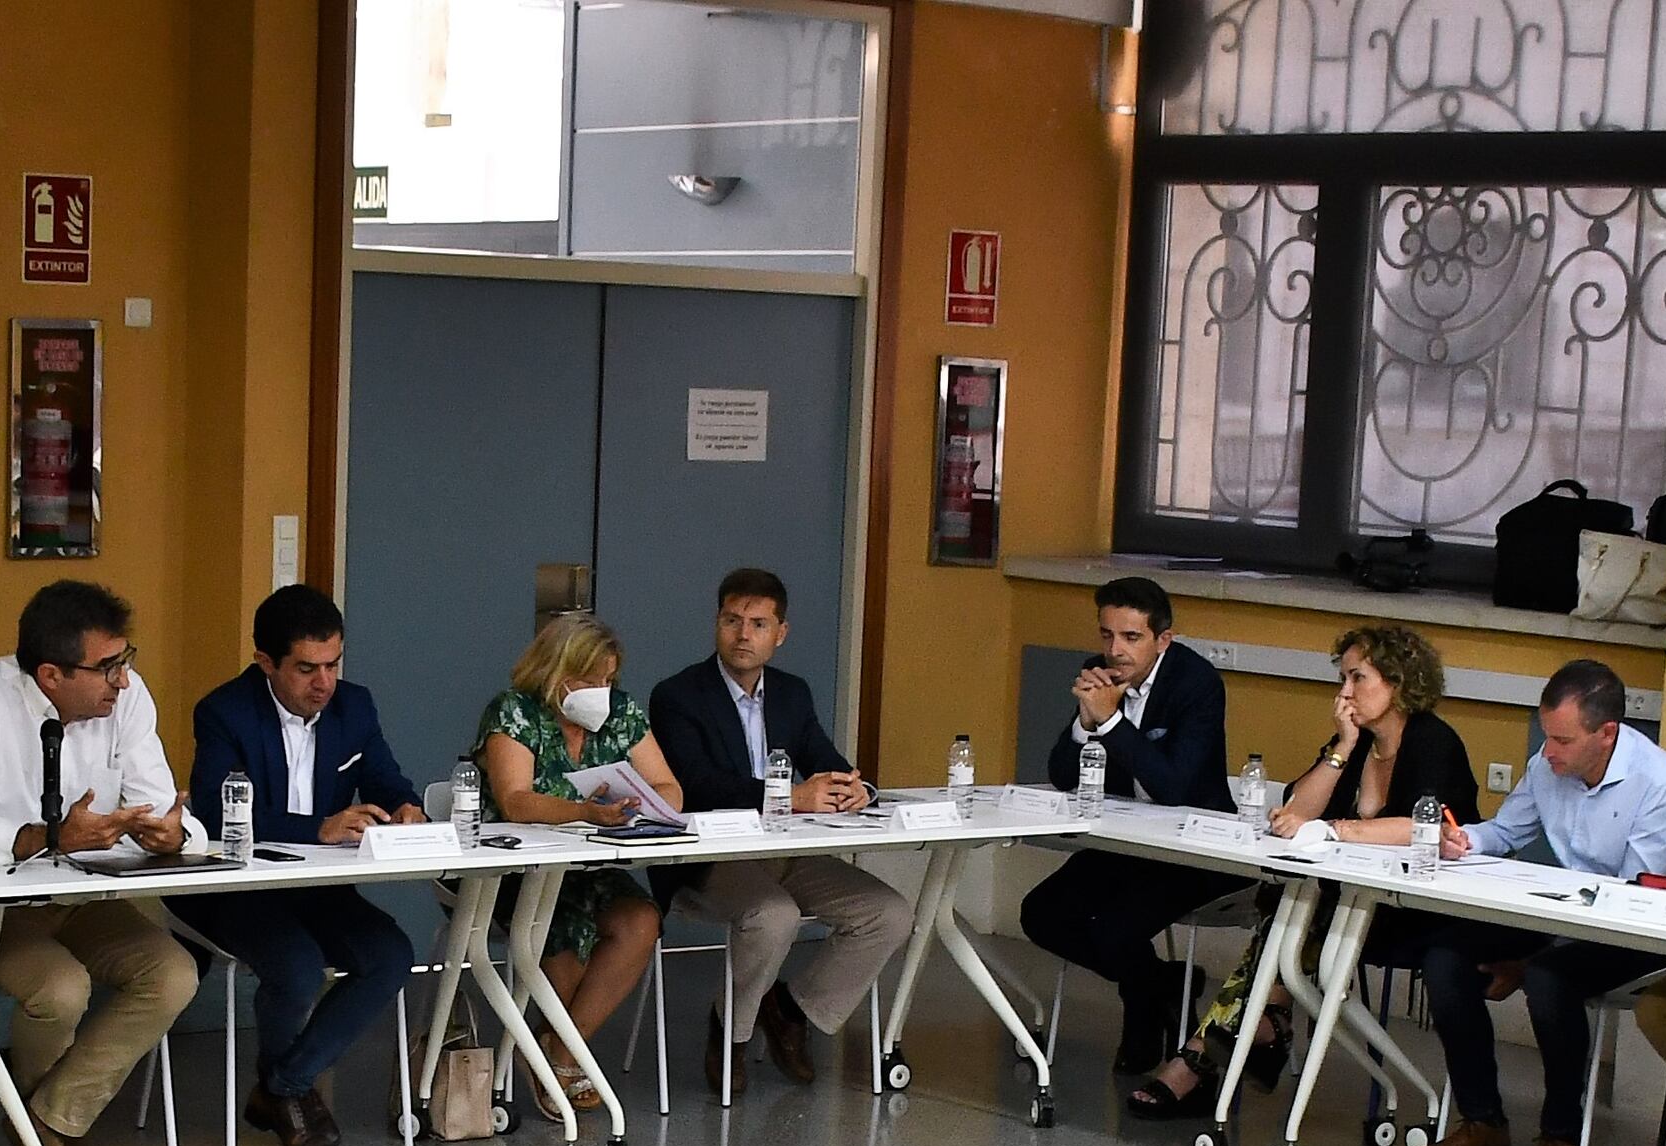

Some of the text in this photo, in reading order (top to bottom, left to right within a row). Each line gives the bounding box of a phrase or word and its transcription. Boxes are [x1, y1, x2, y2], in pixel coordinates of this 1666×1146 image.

[353, 175, 387, 209] ALIDA
[28, 260, 85, 273] EXTINTOR
[951, 305, 991, 315] EXTINTOR
